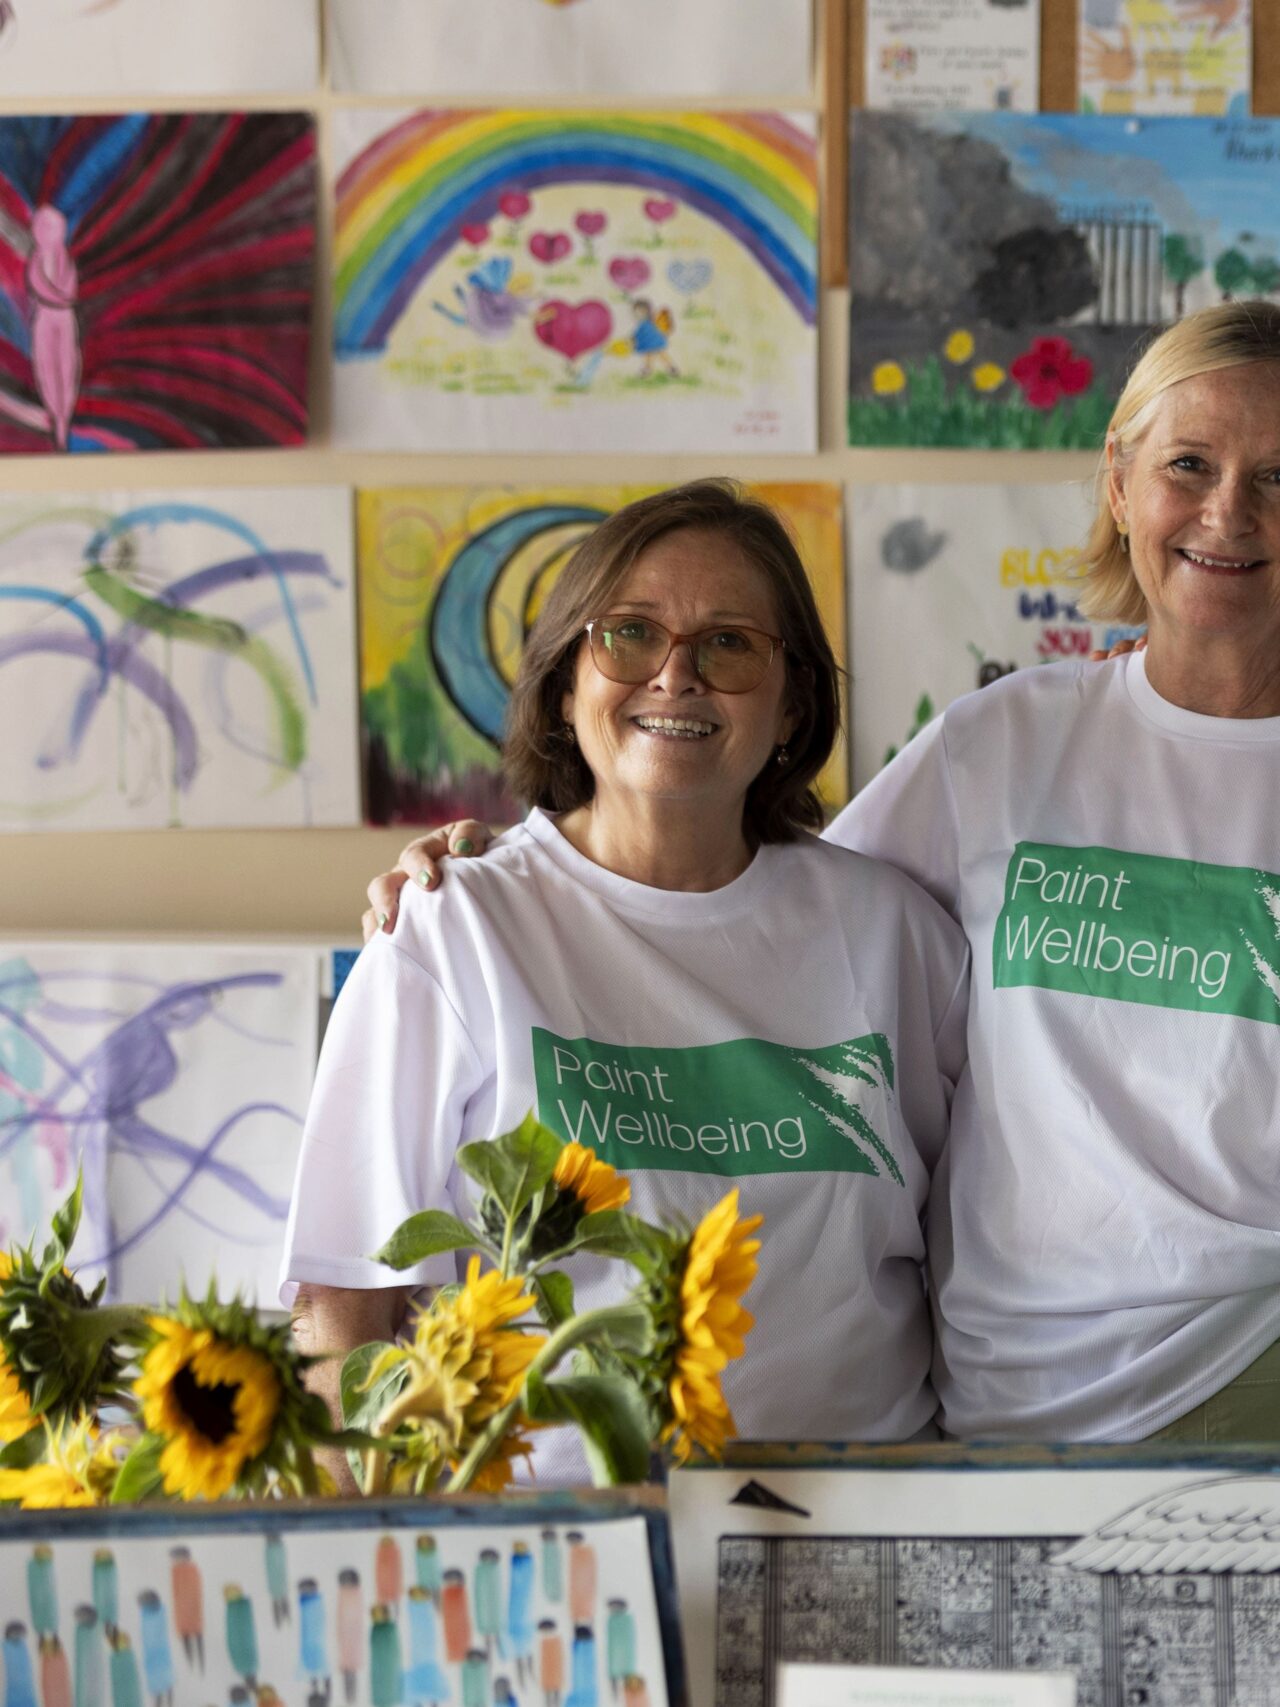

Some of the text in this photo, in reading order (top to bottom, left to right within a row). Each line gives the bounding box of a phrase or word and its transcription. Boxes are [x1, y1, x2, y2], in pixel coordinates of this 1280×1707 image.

[1011, 857, 1131, 911] Paint
[1005, 915, 1231, 998] Wellbeing
[553, 1046, 674, 1103] Paint
[558, 1100, 808, 1159] Wellbeing
